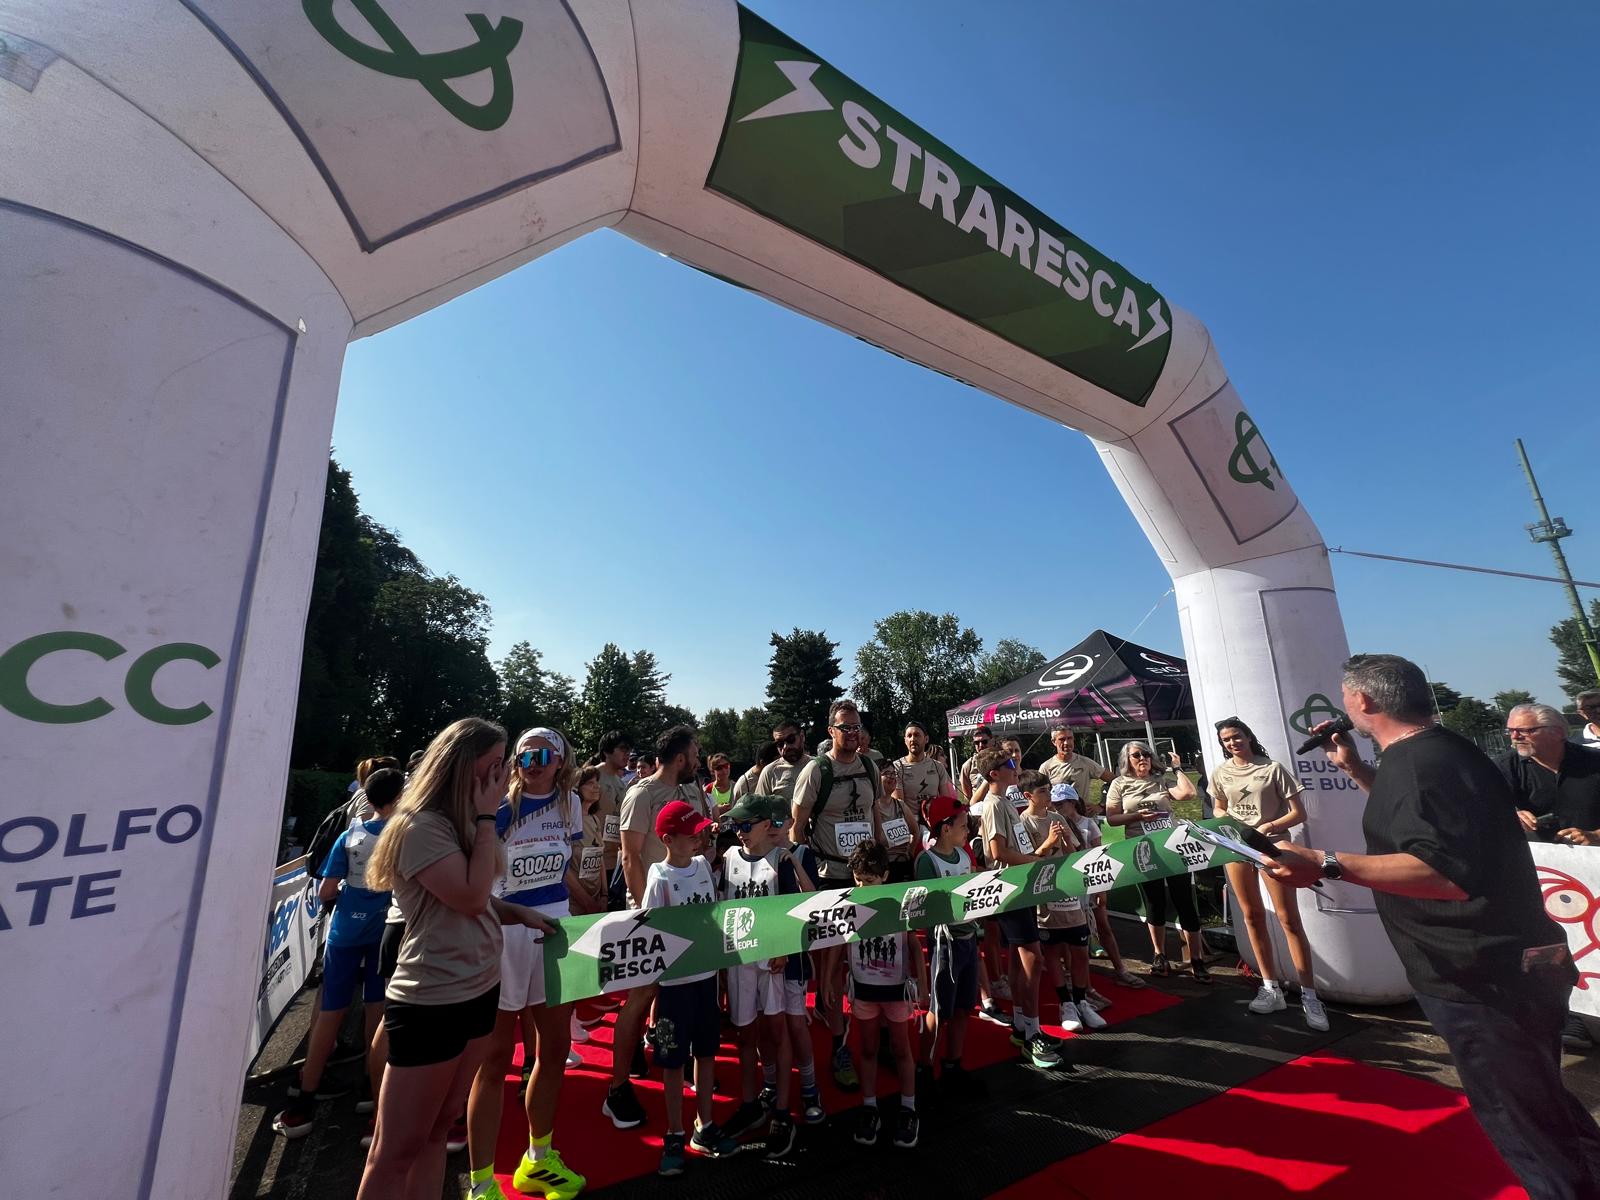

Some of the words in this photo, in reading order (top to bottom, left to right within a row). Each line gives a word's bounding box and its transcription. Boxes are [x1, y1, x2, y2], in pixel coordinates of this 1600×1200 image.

[837, 100, 1141, 338] STRARESCA
[994, 708, 1061, 725] Easy-Gazebo
[1176, 840, 1204, 856] STRA
[513, 853, 564, 878] 30048
[1083, 859, 1112, 876] STRA
[1083, 872, 1115, 888] RESCA
[966, 883, 1003, 899] STRA
[963, 896, 1001, 912] RESCA
[808, 905, 858, 926] STRA
[807, 921, 858, 942] RESCA
[600, 934, 667, 963] STRA
[600, 957, 668, 984] RESCA
